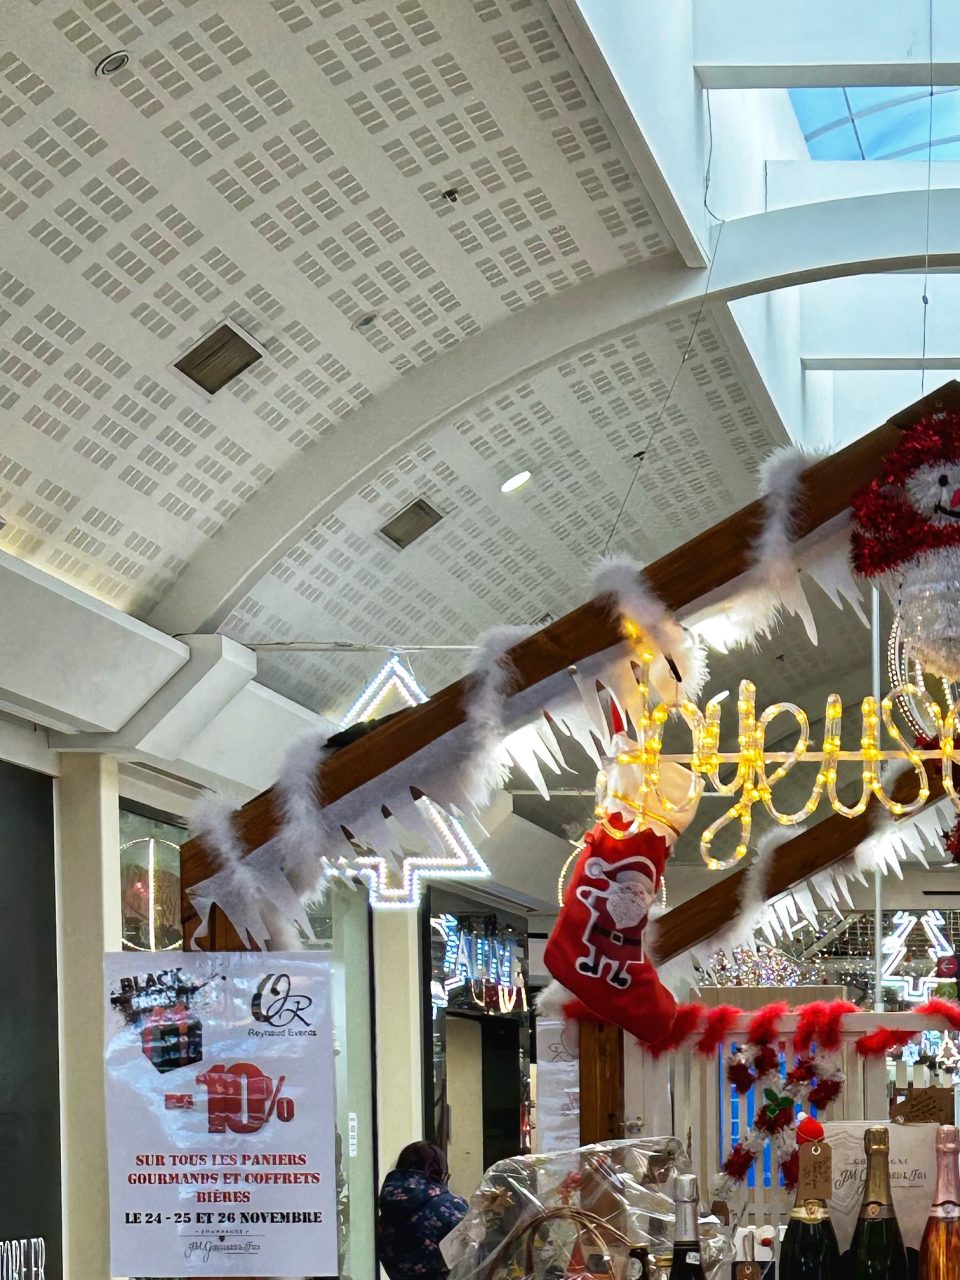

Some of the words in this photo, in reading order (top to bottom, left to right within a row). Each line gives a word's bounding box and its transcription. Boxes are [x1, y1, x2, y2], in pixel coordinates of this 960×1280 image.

[136, 1154, 166, 1167] SUR
[169, 1154, 208, 1167] TOUS
[212, 1154, 239, 1167] LES
[242, 1154, 308, 1167] PANIERS
[127, 1172, 219, 1186] GOURMANDS
[223, 1172, 242, 1185] ET
[245, 1172, 321, 1185] COFFRETS
[196, 1188, 251, 1204] BIÈRES
[125, 1212, 143, 1225] LE
[145, 1212, 163, 1225] 24
[174, 1212, 192, 1225] 25
[196, 1212, 213, 1225] ET
[217, 1212, 237, 1225] 26
[240, 1212, 323, 1225] NOVEMBRE
